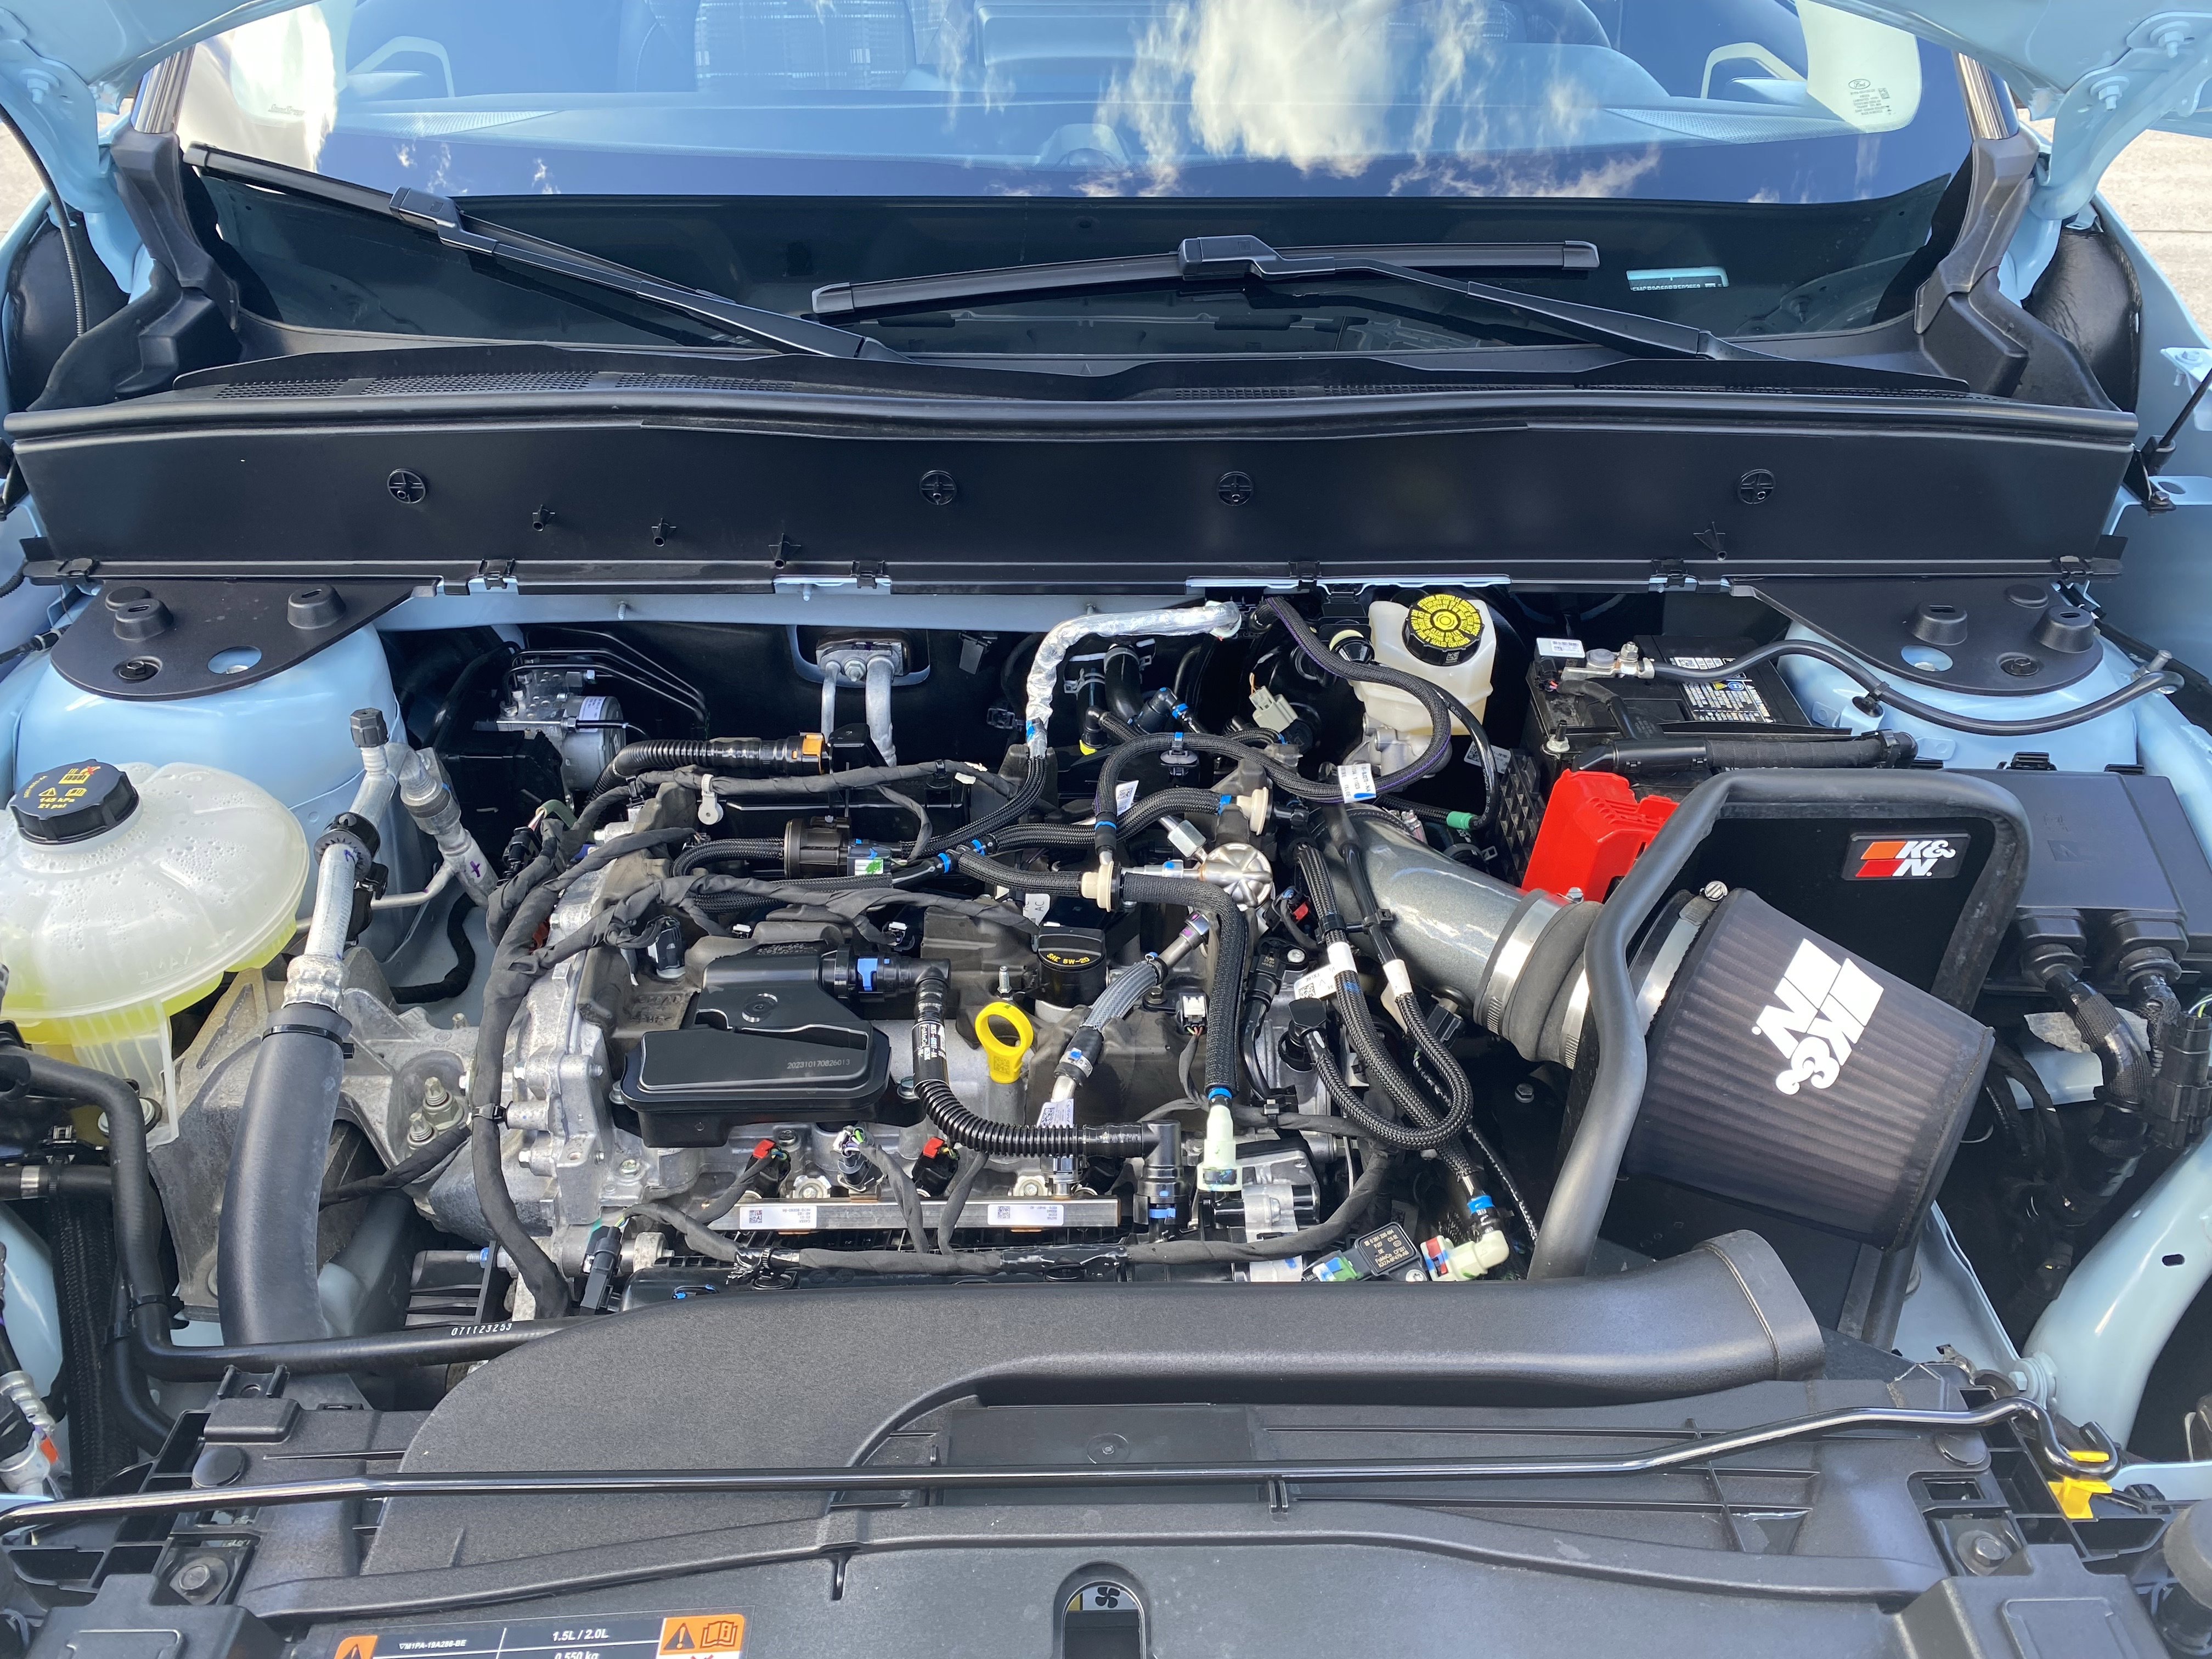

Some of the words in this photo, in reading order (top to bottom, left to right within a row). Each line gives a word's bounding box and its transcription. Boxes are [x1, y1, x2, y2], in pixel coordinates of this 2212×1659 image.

[1430, 628, 1445, 637] CLEAN
[1430, 640, 1447, 648] SEALED
[1447, 637, 1471, 648] CONTAINER
[1047, 953, 1061, 962] SAE
[1063, 957, 1091, 965] 5W-20
[1375, 1252, 1392, 1264] FoMoCo
[451, 1323, 512, 1336] 071123253
[552, 1630, 576, 1642] 1.5L
[577, 1629, 583, 1641] /
[584, 1628, 610, 1640] 2.0L
